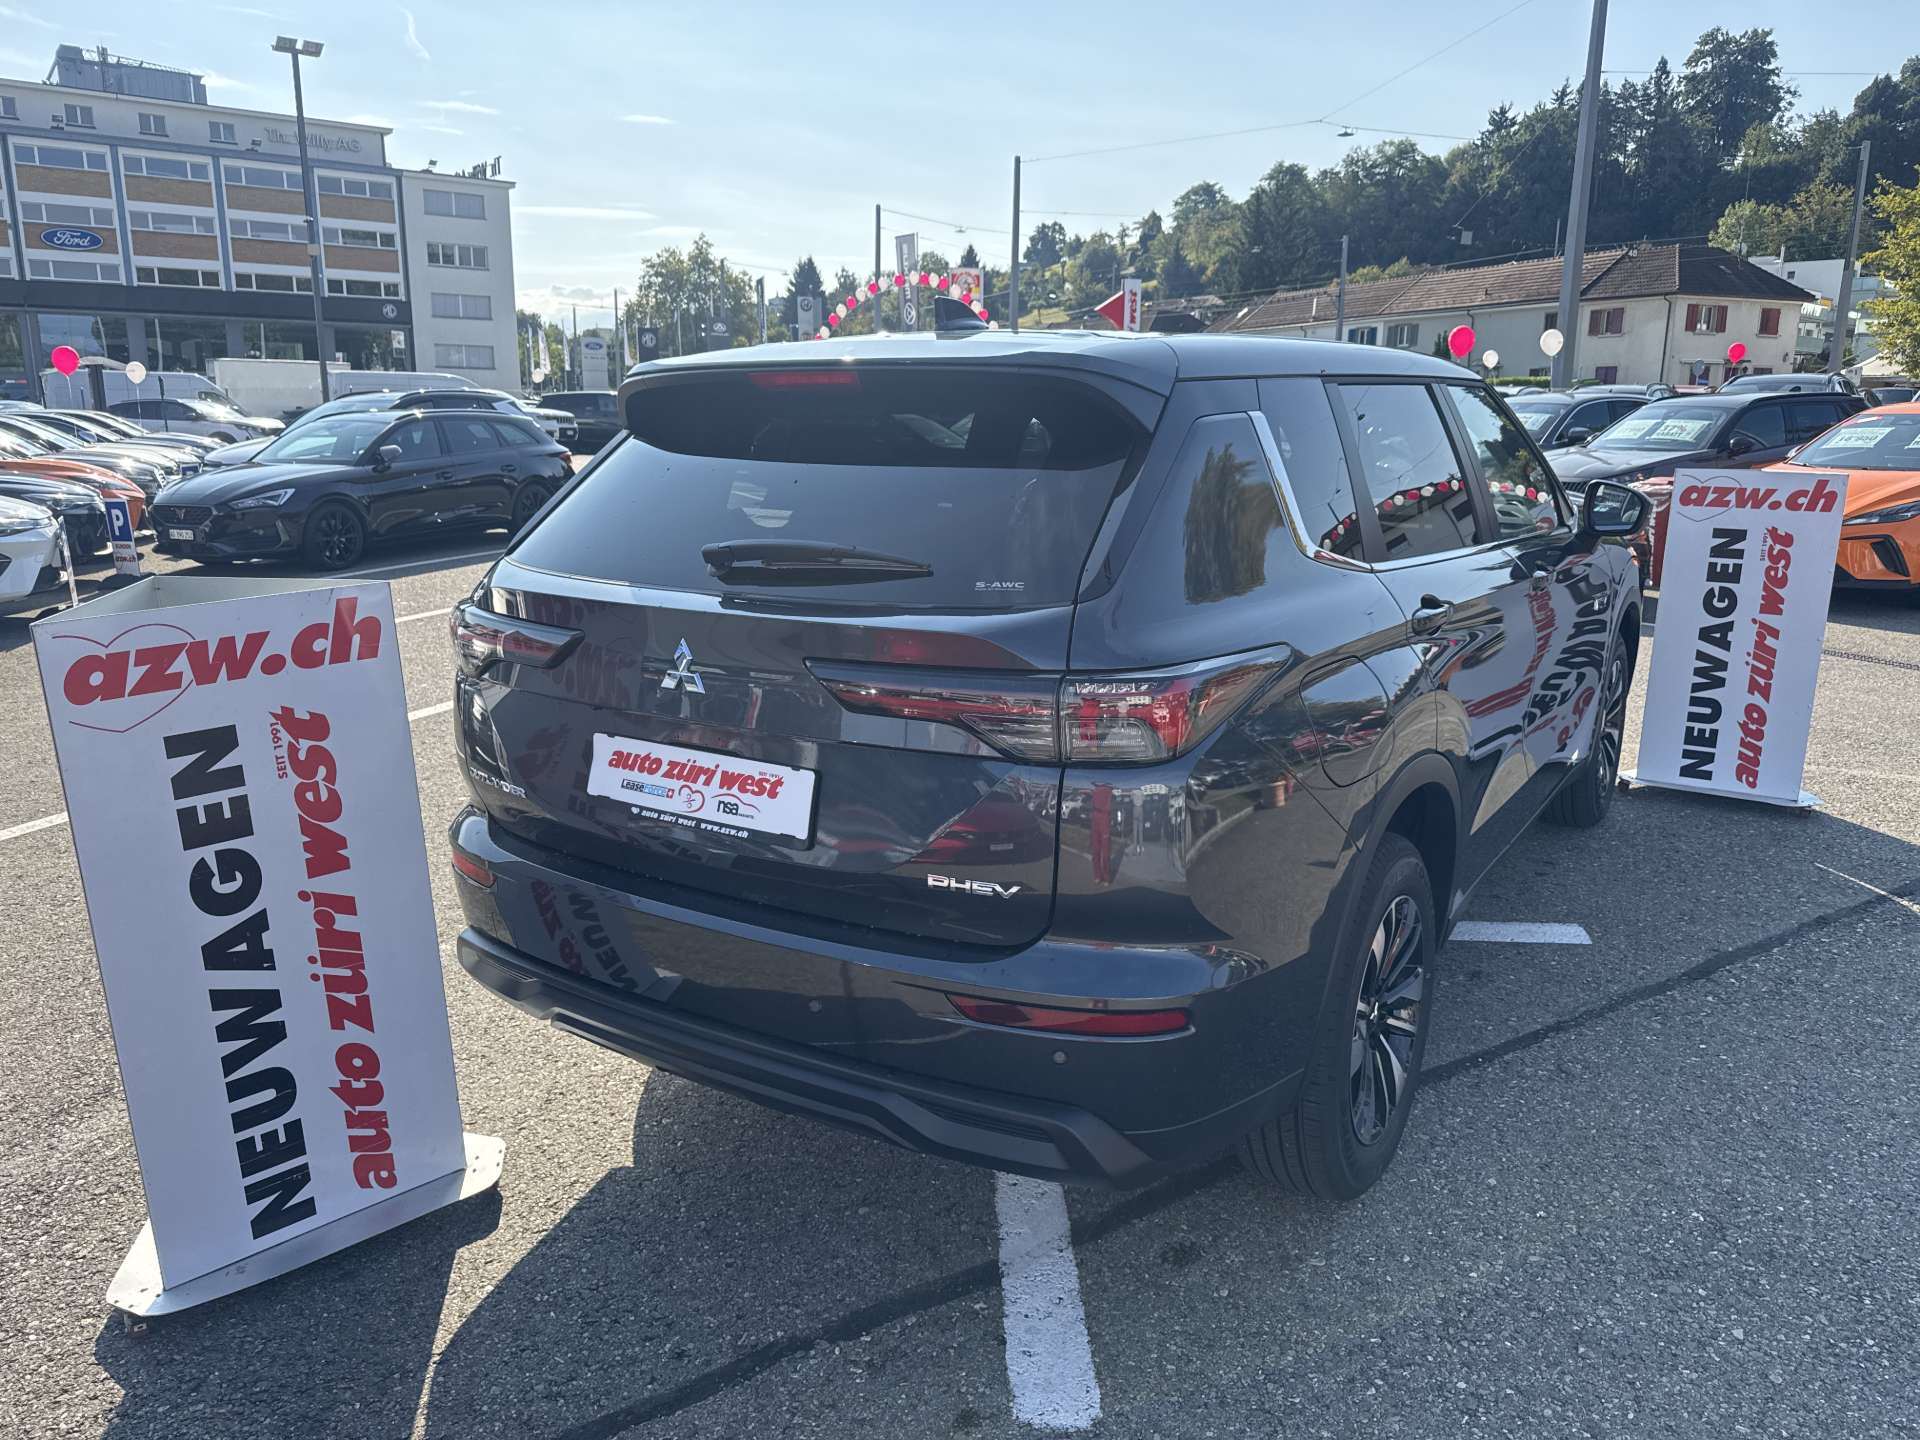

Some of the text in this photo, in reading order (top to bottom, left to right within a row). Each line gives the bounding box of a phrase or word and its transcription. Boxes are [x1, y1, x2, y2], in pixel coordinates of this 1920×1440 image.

[336, 136, 362, 152] AG
[54, 230, 91, 246] Ford
[1679, 479, 1838, 513] azw.ch
[111, 508, 124, 536] P
[64, 598, 381, 706] azw.ch
[1679, 527, 1748, 781] NEUWAGEN
[1735, 526, 1794, 789] auto züri west
[269, 721, 288, 779] SEIT 1991
[608, 750, 785, 800] auto züri west
[641, 809, 659, 819] auto
[678, 817, 697, 828] west
[700, 822, 749, 839] www.azw.ch
[717, 800, 739, 817] nsa
[927, 873, 1022, 899] PHEV
[269, 705, 398, 1189] auto züri west
[163, 724, 318, 1240] NEUWAGEN
